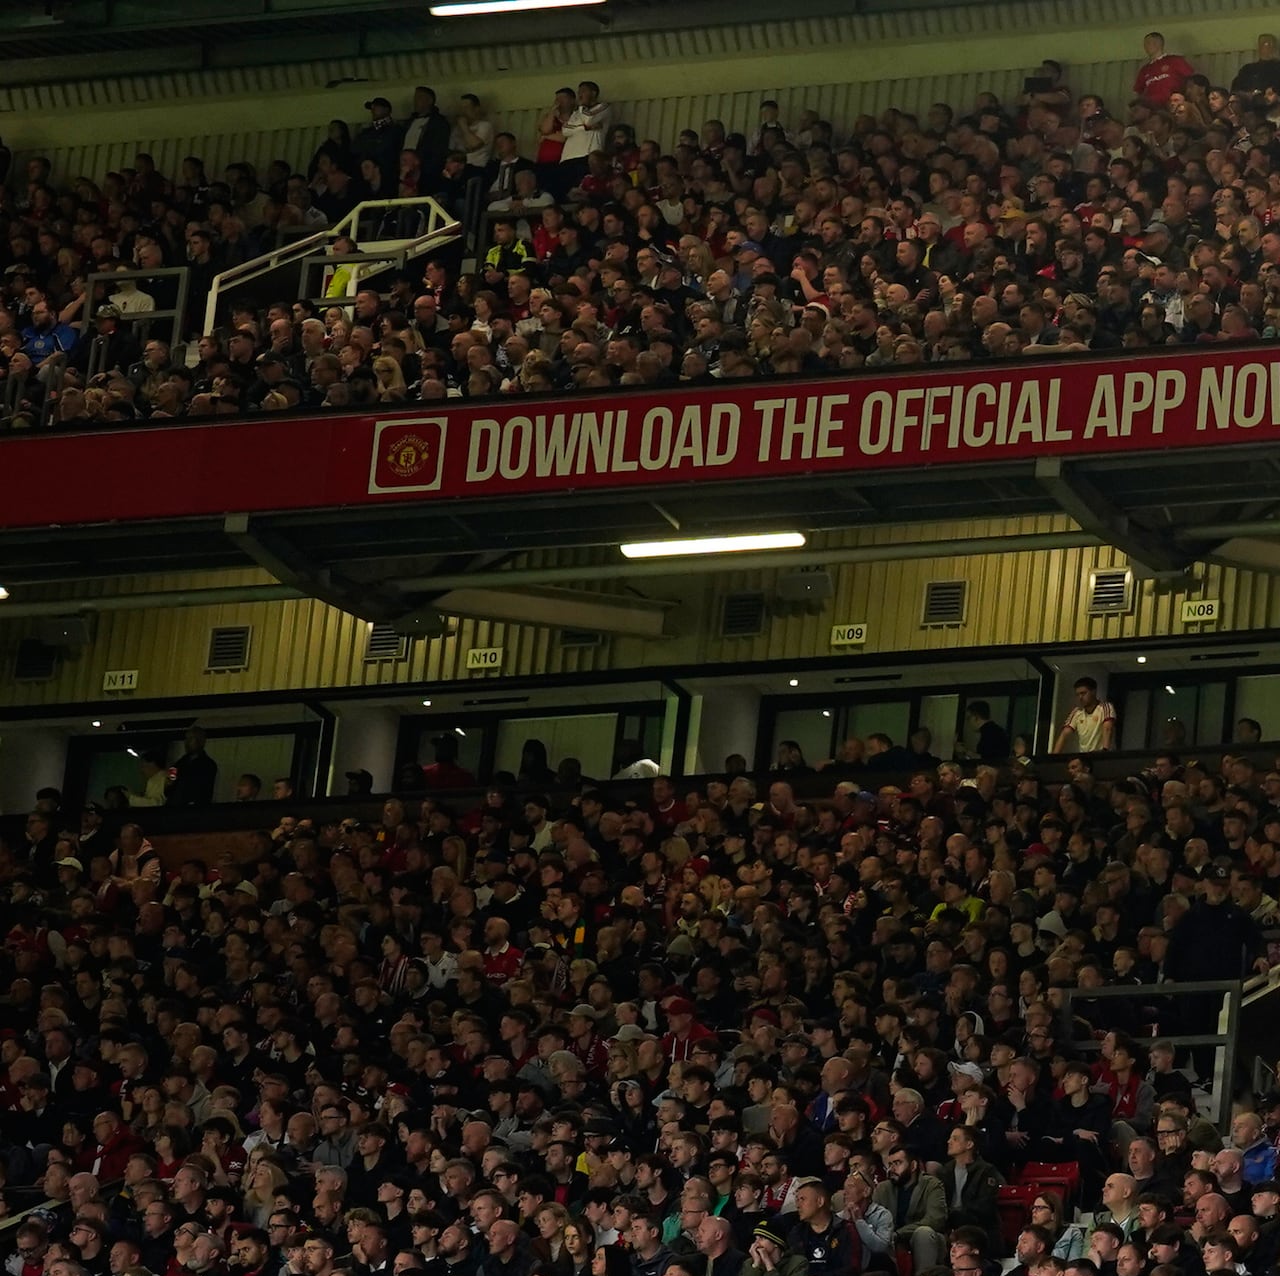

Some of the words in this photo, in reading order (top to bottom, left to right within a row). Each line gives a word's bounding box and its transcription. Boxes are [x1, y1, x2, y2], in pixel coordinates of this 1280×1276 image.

[466, 403, 740, 481] DOWNLOAD
[754, 395, 849, 461] THE
[860, 379, 1072, 454] OFFICIAL
[1084, 370, 1186, 438] APP
[1187, 604, 1214, 616] N08
[836, 628, 863, 640] N09
[471, 652, 497, 664] N10
[108, 674, 133, 686] N11
